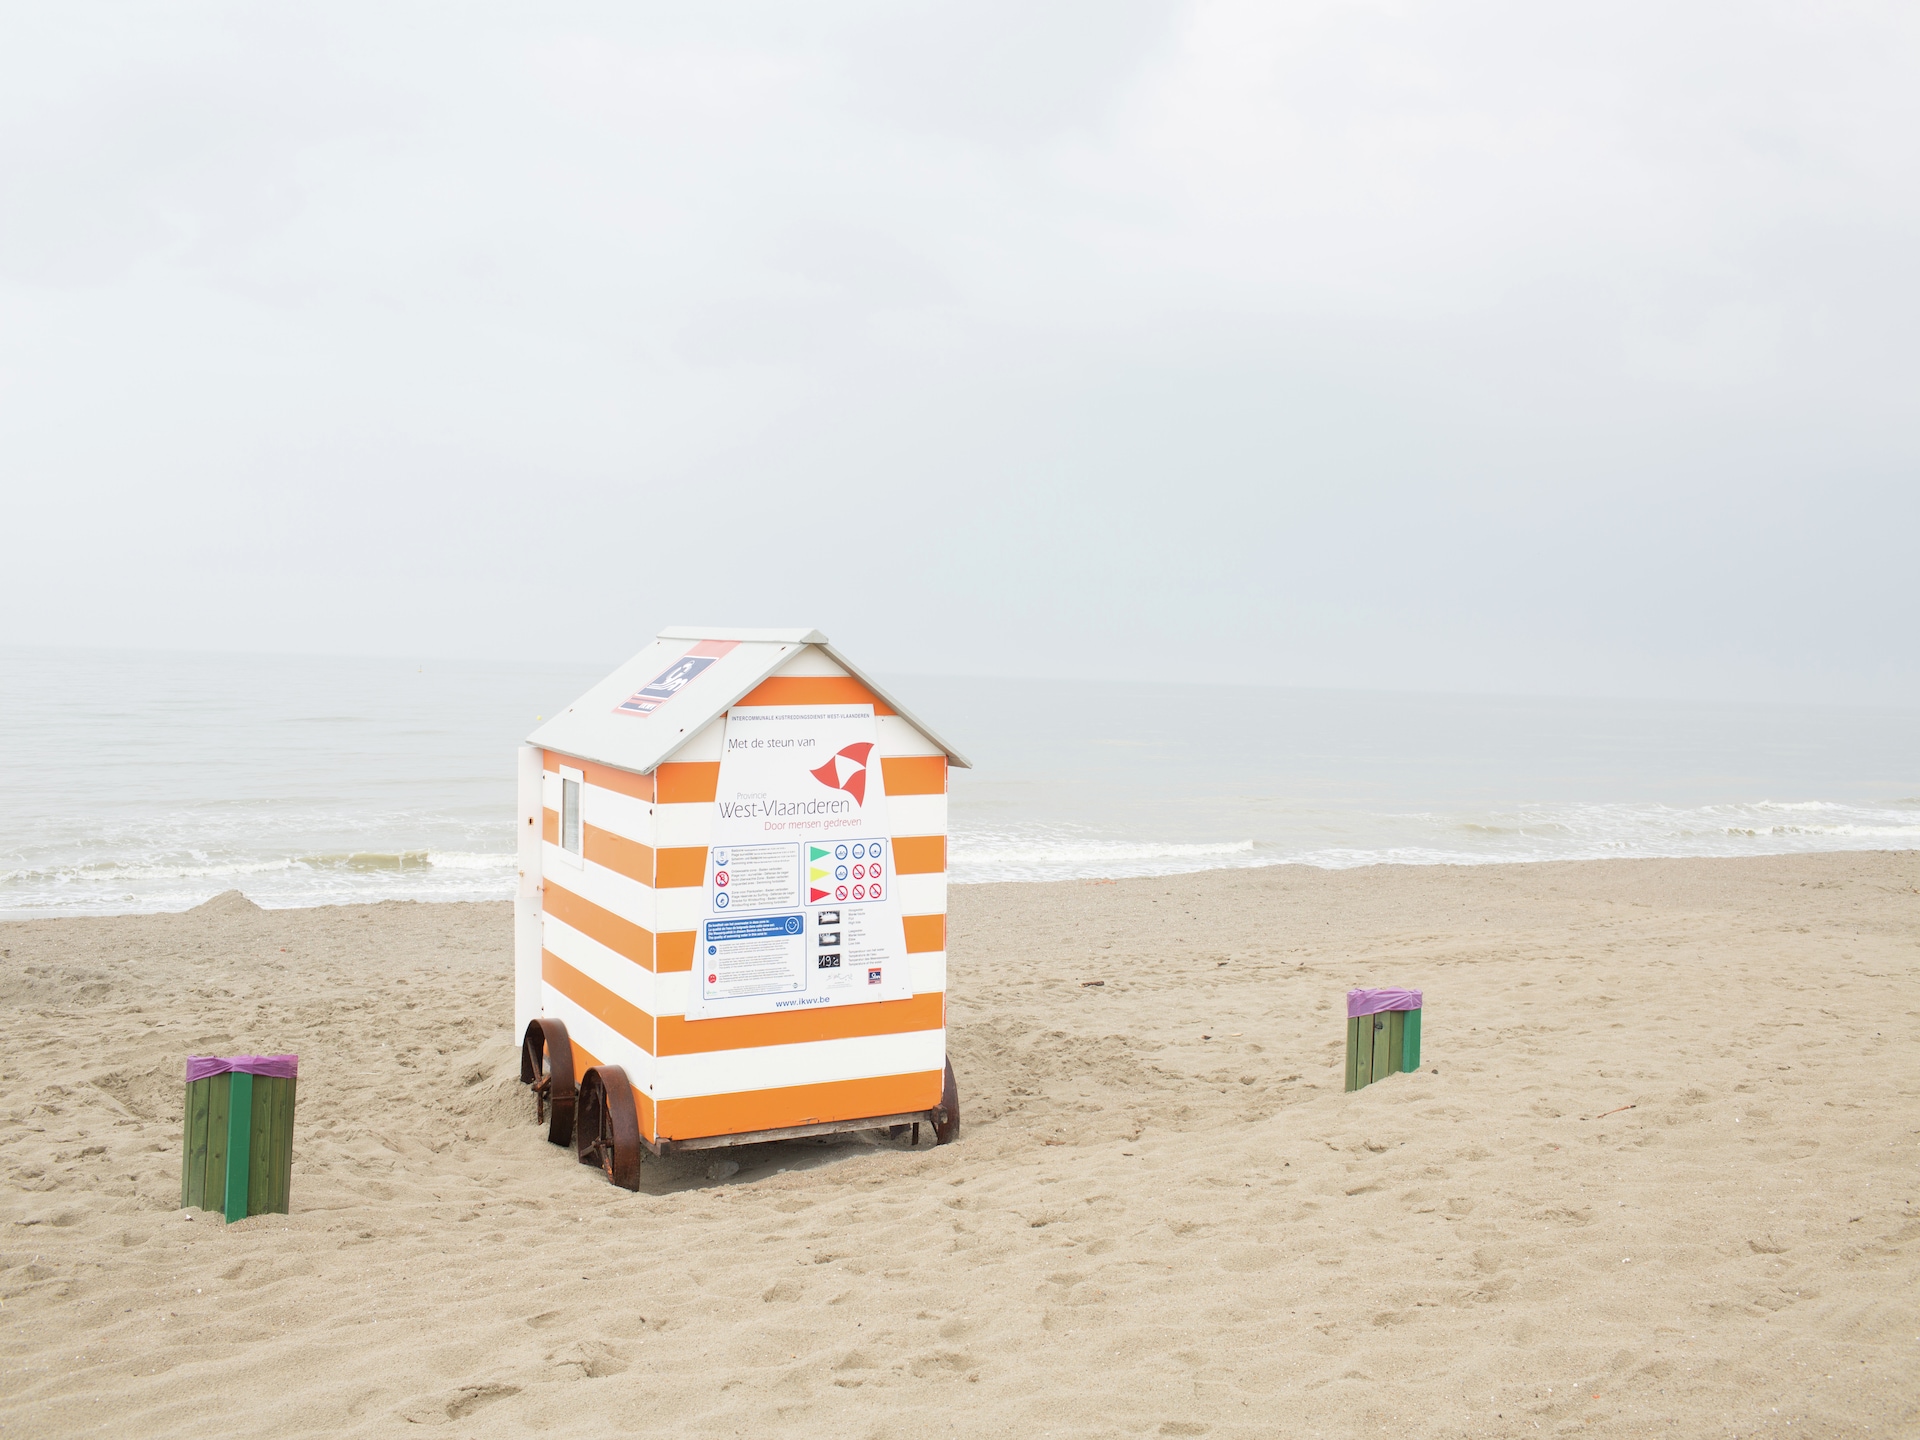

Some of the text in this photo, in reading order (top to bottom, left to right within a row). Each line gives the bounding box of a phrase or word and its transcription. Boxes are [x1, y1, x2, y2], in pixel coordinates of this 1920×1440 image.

[728, 738, 815, 749] Met de steun van
[719, 799, 850, 819] West-Vlaanderen
[764, 818, 862, 831] Door mensen gedreven
[776, 996, 830, 1007] www.ikwv.be
